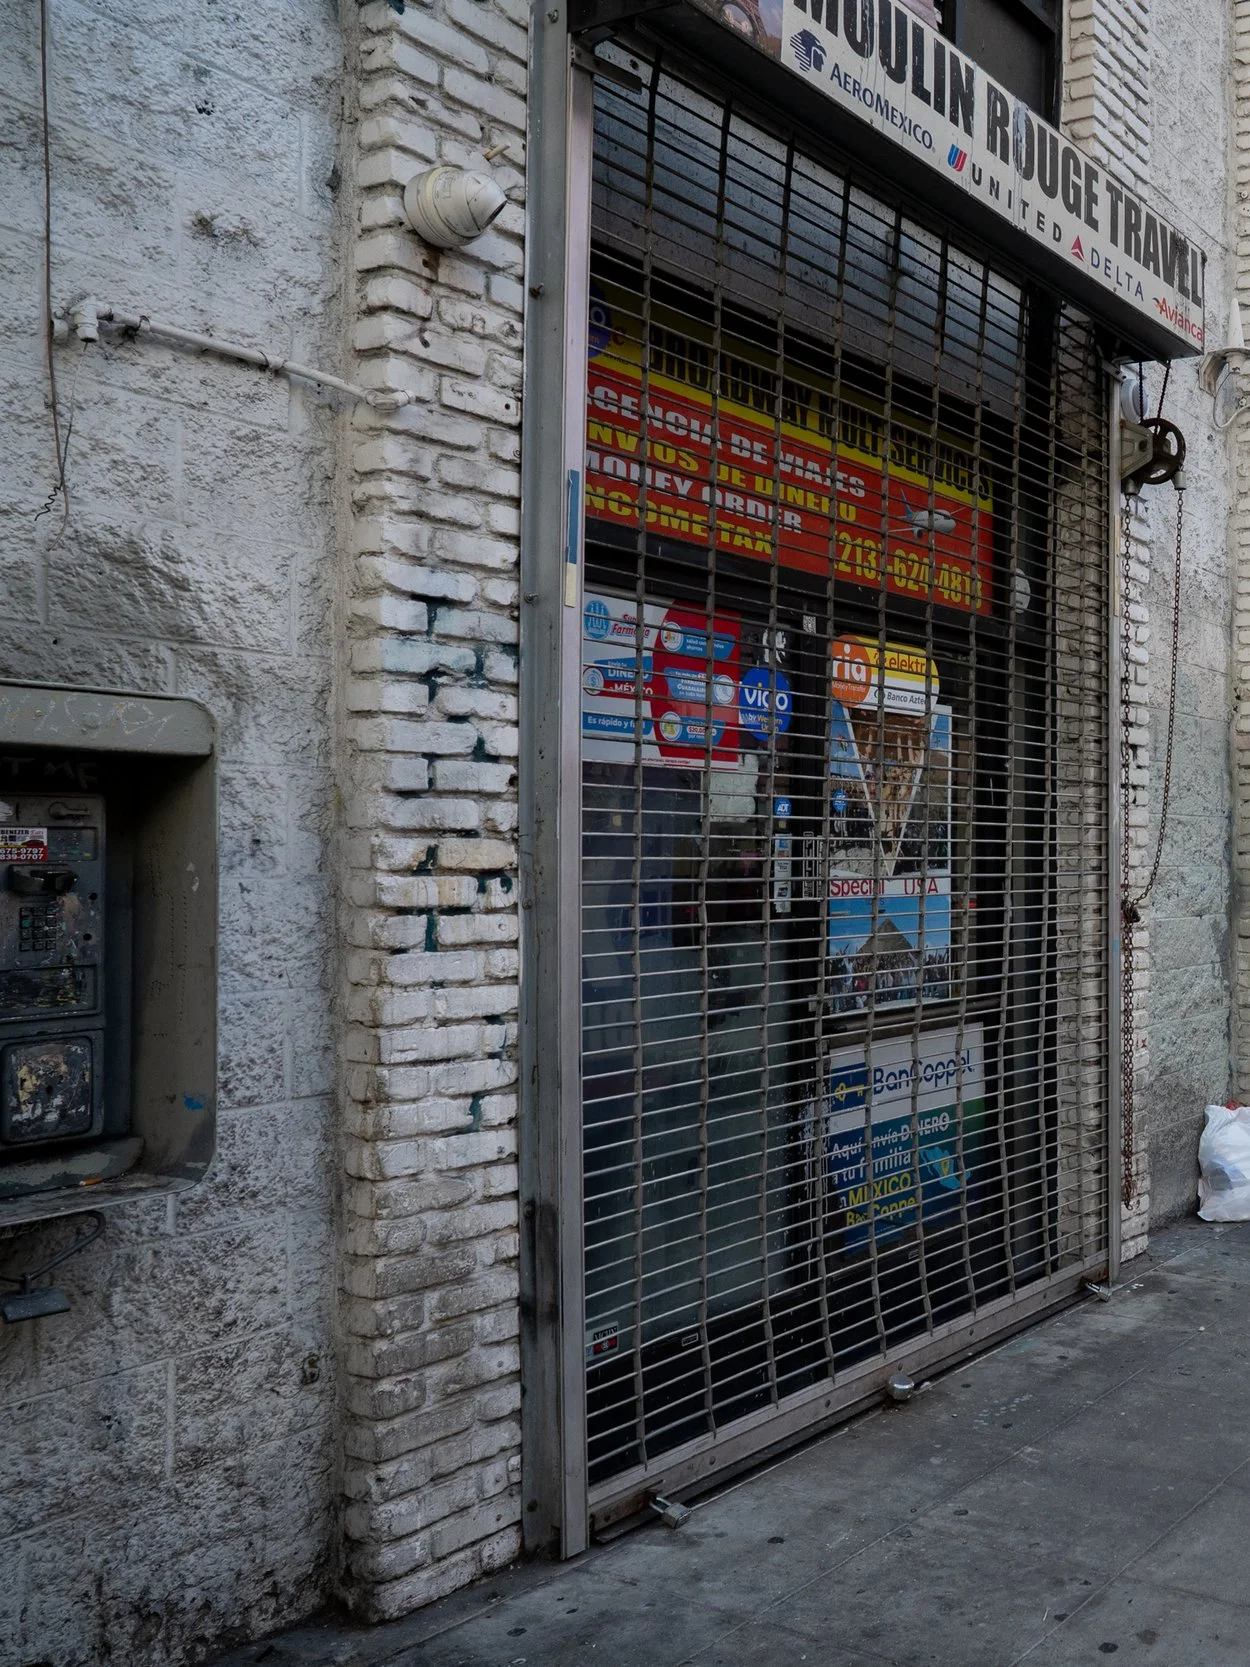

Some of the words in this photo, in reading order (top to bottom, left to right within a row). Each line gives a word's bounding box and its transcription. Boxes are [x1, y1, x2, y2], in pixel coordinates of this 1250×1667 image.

[830, 63, 934, 150] AEROMEXICO
[971, 163, 1063, 244] UNITED
[987, 81, 1099, 233] ROUGE
[1106, 178, 1202, 309] TRAVEL
[1091, 247, 1144, 302] DELTA
[1159, 297, 1204, 342] Avianca
[587, 420, 700, 473] NVIOS
[731, 431, 768, 465] DE
[585, 484, 708, 539] NCOME
[717, 520, 774, 556] TAX
[608, 668, 650, 680] DINEO
[832, 644, 867, 684] ria
[889, 651, 927, 673] elektr
[614, 682, 654, 696] MÉXO
[887, 691, 908, 703] Banco
[909, 694, 928, 706] Azte
[598, 717, 623, 728] rápido
[776, 803, 790, 813] ADT
[873, 1050, 972, 1096] BanCoppel
[831, 1136, 863, 1161] Aquí
[870, 1128, 899, 1150] nvía
[901, 1112, 950, 1140] DNERO
[842, 1169, 856, 1185] tu
[860, 1145, 911, 1180] fmilia
